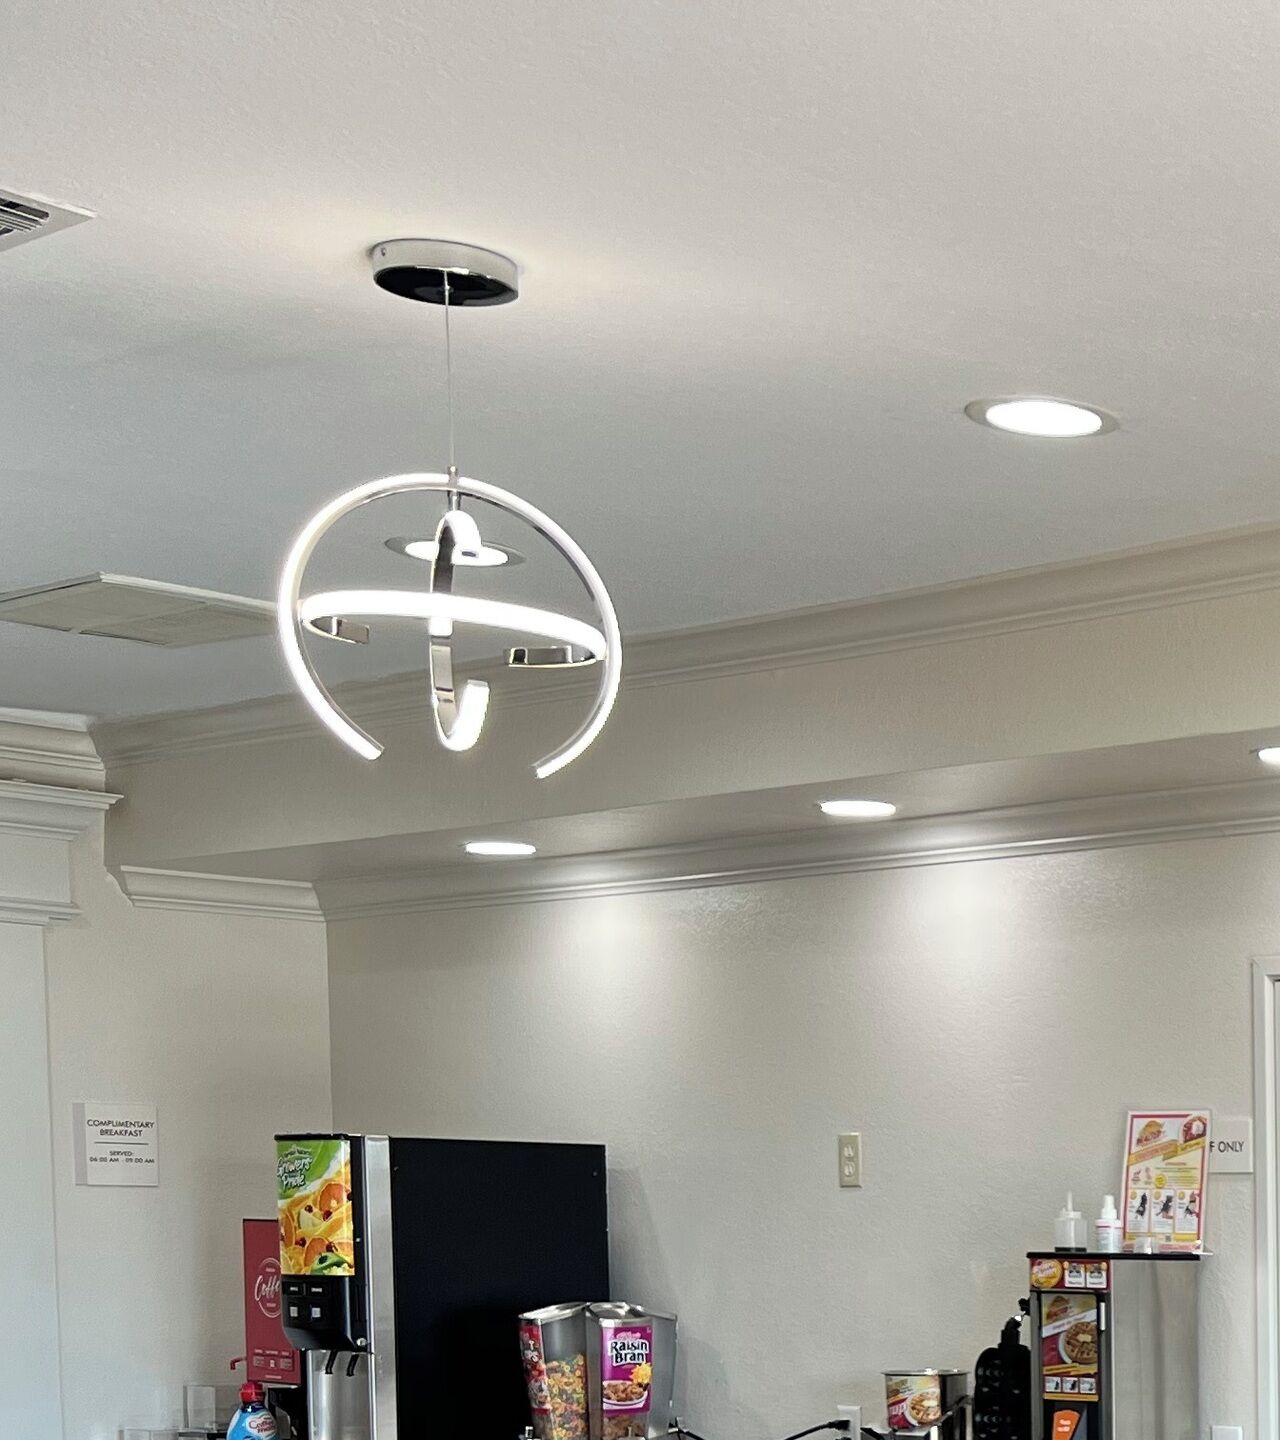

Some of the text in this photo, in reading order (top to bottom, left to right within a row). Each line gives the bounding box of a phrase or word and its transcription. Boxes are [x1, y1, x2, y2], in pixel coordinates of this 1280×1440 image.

[87, 1119, 155, 1129] COMPLIMENTARY
[100, 1129, 143, 1137] BREAKFAST
[1217, 1140, 1245, 1153] ONLY
[610, 1341, 648, 1353] Raisin
[614, 1351, 646, 1363] Bran
